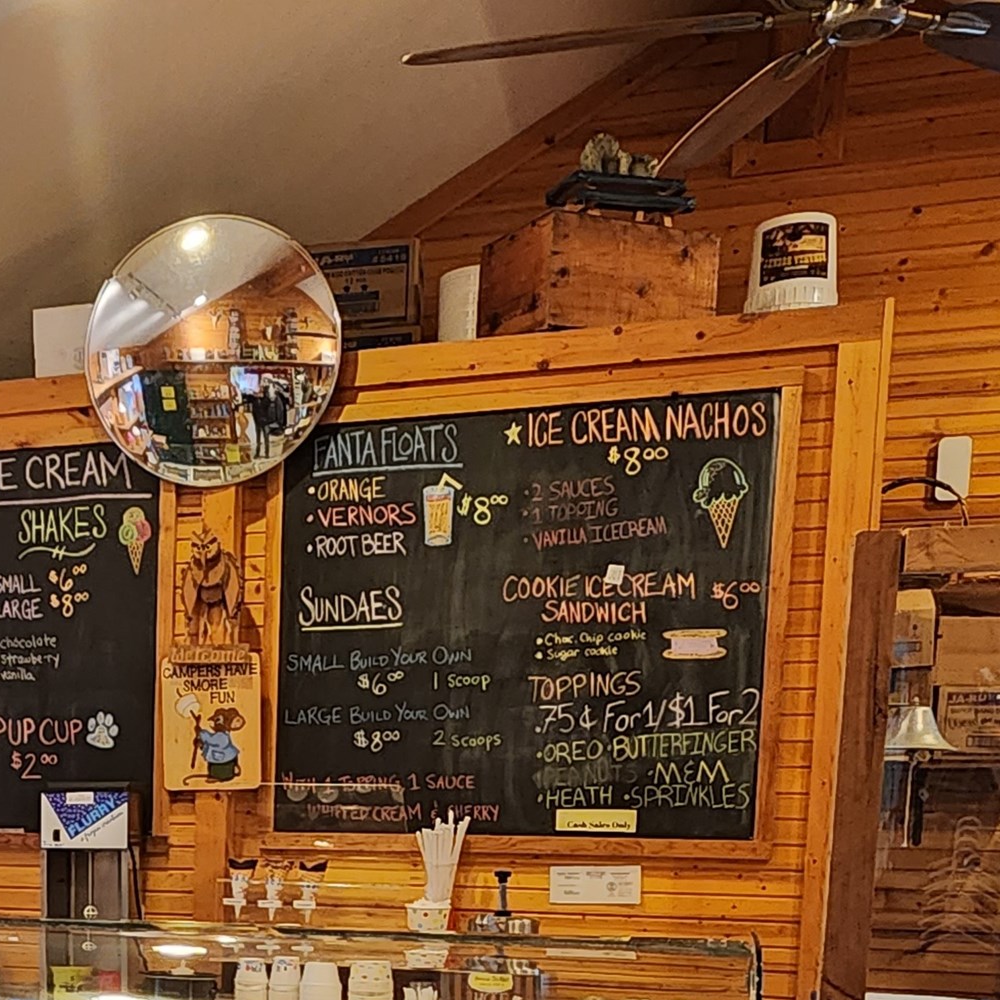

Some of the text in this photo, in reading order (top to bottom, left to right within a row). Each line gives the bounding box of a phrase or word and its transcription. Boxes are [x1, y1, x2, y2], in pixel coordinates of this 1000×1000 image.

[527, 400, 768, 447] ICE CREAM NACHOS
[314, 423, 458, 471] FANTA FLOATS
[25, 451, 132, 490] CREAM
[317, 476, 386, 503] ORANGE
[532, 476, 616, 503] 2 SAUCES
[318, 503, 417, 528] VERNORS
[550, 498, 619, 520] TOPPING
[18, 504, 107, 544] SHAKES
[315, 531, 407, 559] ROOT BEER
[532, 527, 588, 550] VANILLA
[503, 574, 581, 601] COOKIE
[616, 571, 697, 600] CREAM
[299, 585, 402, 626] SUNDAES
[541, 601, 647, 624] SANDWICH
[607, 629, 647, 643] cookie
[286, 653, 345, 675] SMALL
[546, 645, 618, 662] Sugar cookie
[162, 662, 258, 679] CAMPERS HAVE
[433, 671, 439, 690] 1
[209, 691, 235, 705] FUN
[528, 670, 642, 702] TOPPINGS
[284, 705, 343, 726] LARGE
[738, 688, 760, 725] 2
[39, 717, 83, 746] CUP
[432, 730, 447, 746] 2
[543, 728, 757, 765] OREO BUTTERFINGER
[407, 773, 421, 791] 1
[425, 773, 476, 789] SAUCE
[546, 783, 751, 809] HEATH SPRINKLES
[372, 803, 422, 822] CREAM
